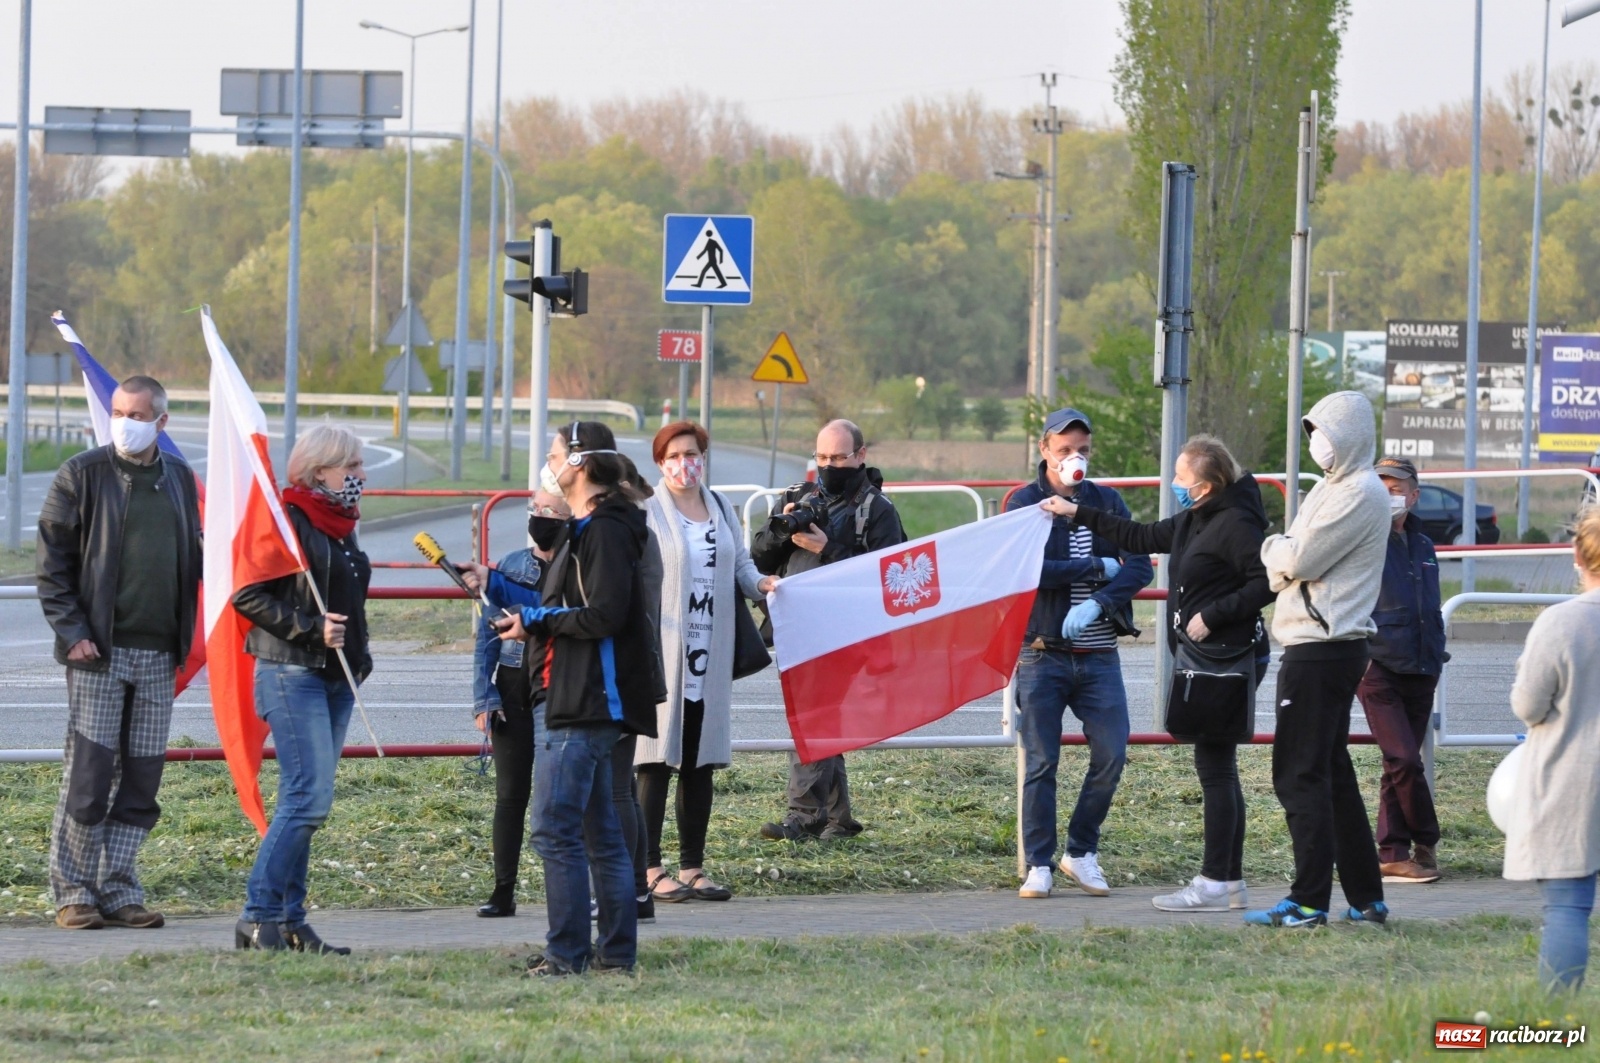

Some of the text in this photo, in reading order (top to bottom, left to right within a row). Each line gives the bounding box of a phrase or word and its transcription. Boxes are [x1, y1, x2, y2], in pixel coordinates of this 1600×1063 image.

[1389, 323, 1459, 338] KOLEJARZ
[672, 337, 696, 356] 78
[1388, 338, 1459, 349] BEST FOR YOU
[1481, 418, 1491, 431] W
[687, 622, 713, 632] ANDING
